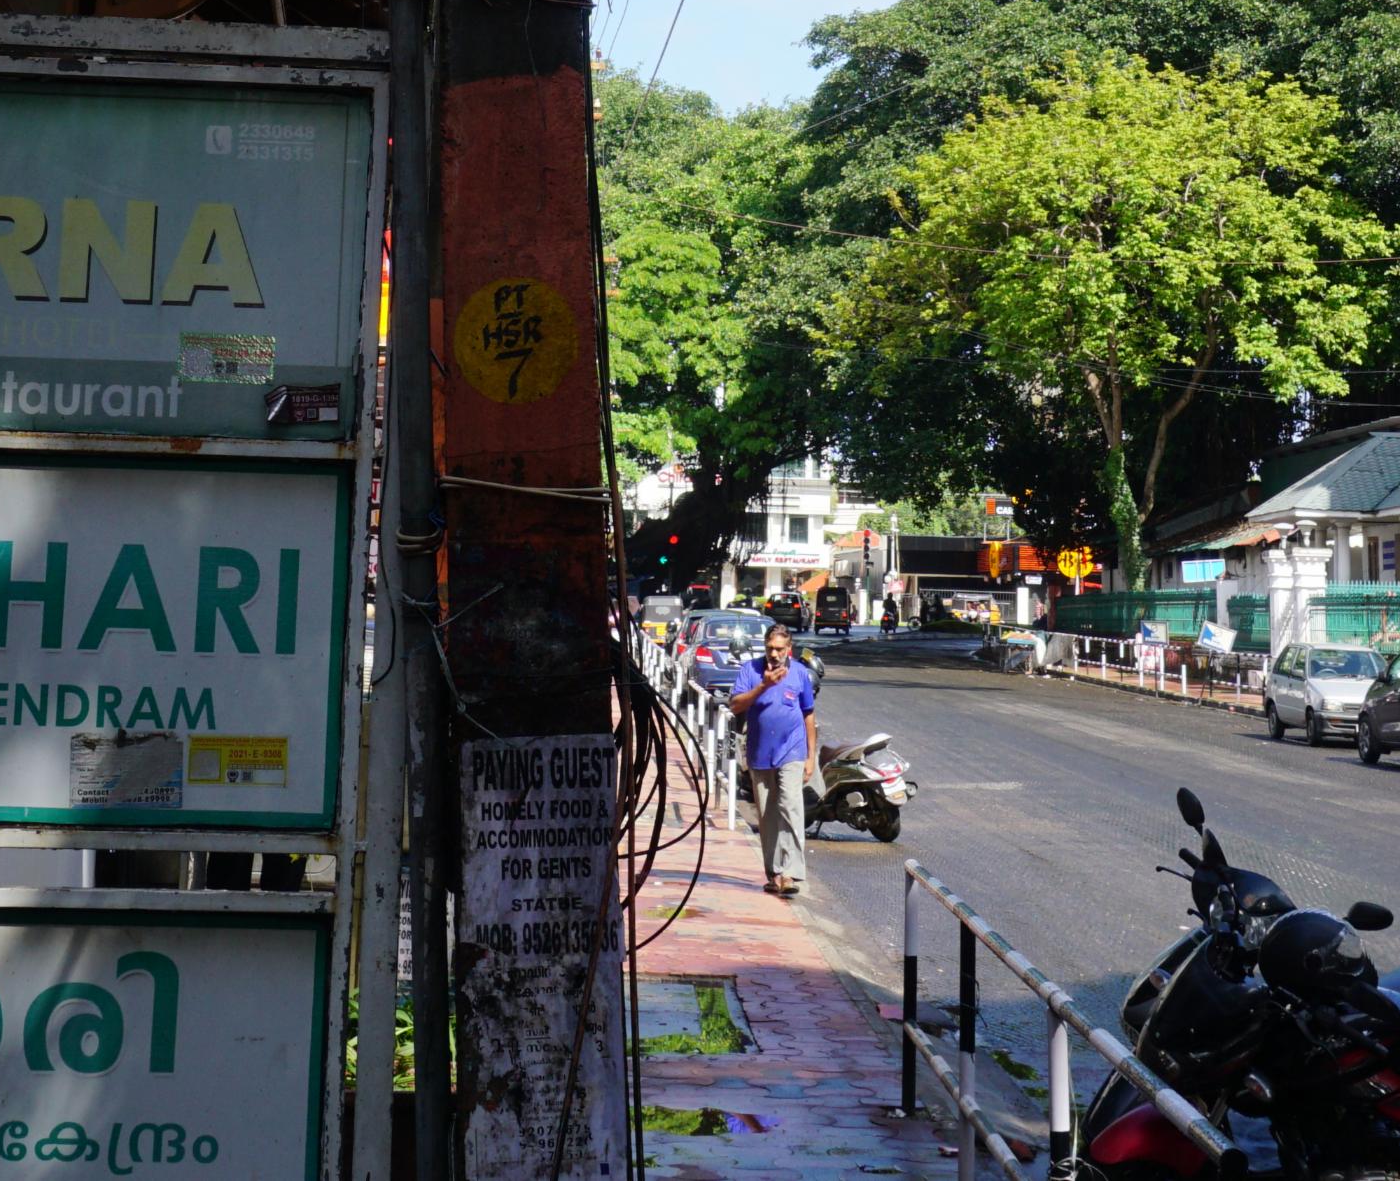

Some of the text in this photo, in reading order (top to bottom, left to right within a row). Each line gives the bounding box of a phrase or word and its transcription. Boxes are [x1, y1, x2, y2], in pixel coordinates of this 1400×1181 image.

[494, 347, 534, 399] 7
[471, 747, 615, 792] PAYING GUEST
[481, 799, 609, 821] HOMELY FOOD &
[501, 857, 592, 881] FOR GENTS
[511, 897, 583, 913] STATUE
